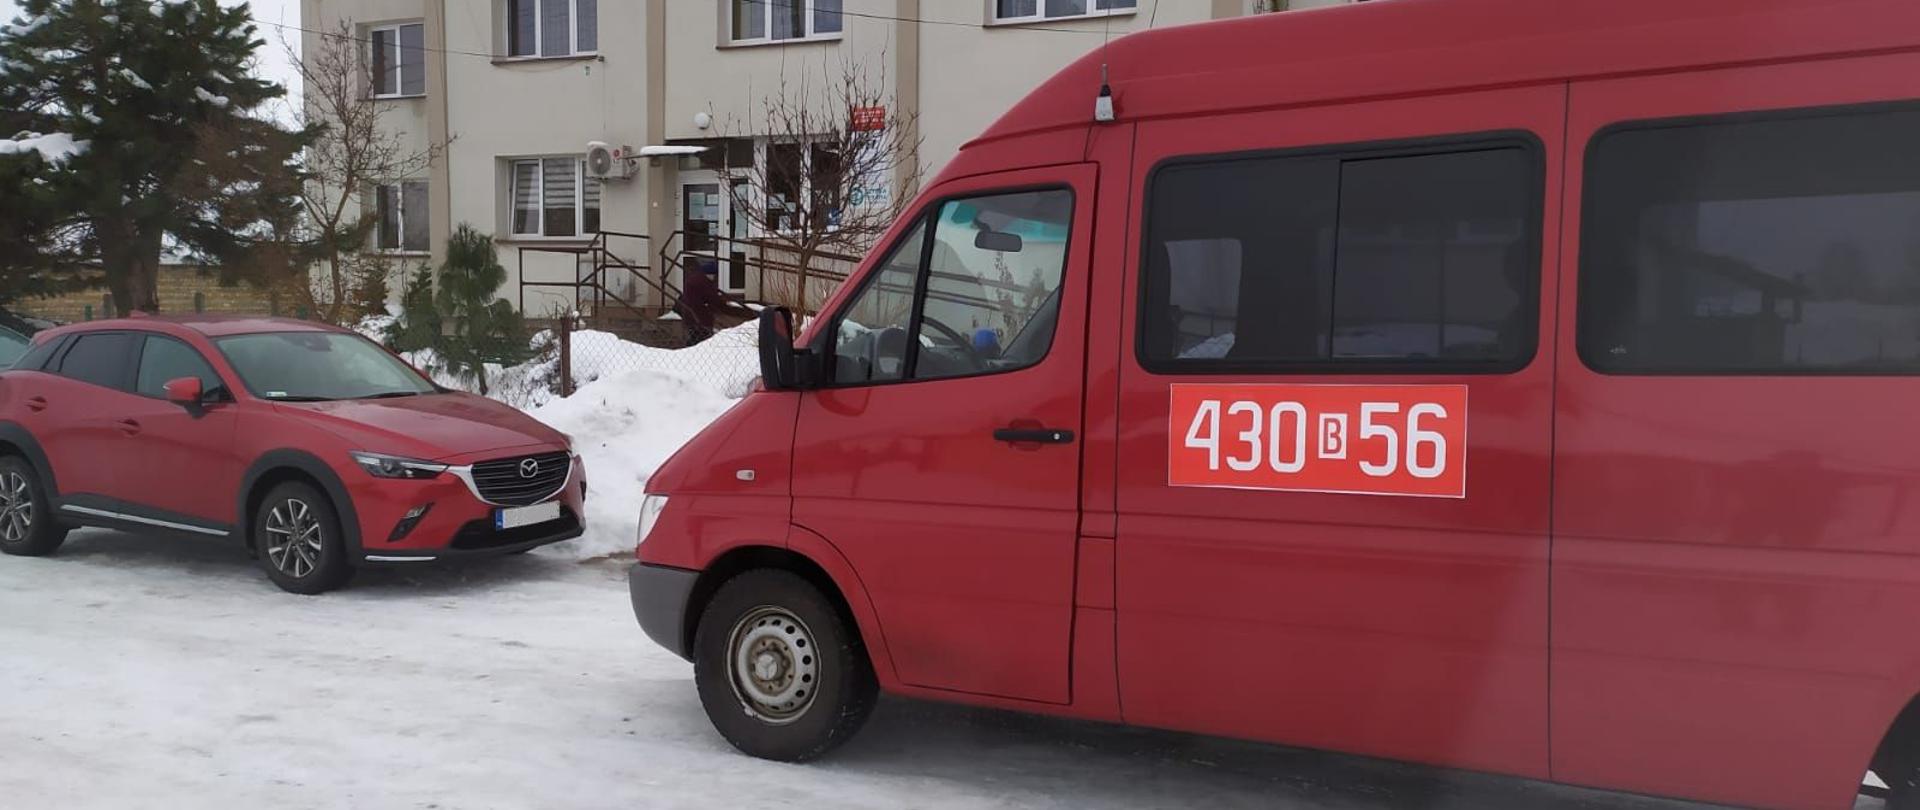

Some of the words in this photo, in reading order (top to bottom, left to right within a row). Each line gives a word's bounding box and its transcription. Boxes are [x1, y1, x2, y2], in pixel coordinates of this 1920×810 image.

[1185, 399, 1306, 473] 430
[1322, 416, 1343, 455] B
[1358, 401, 1448, 479] 56
